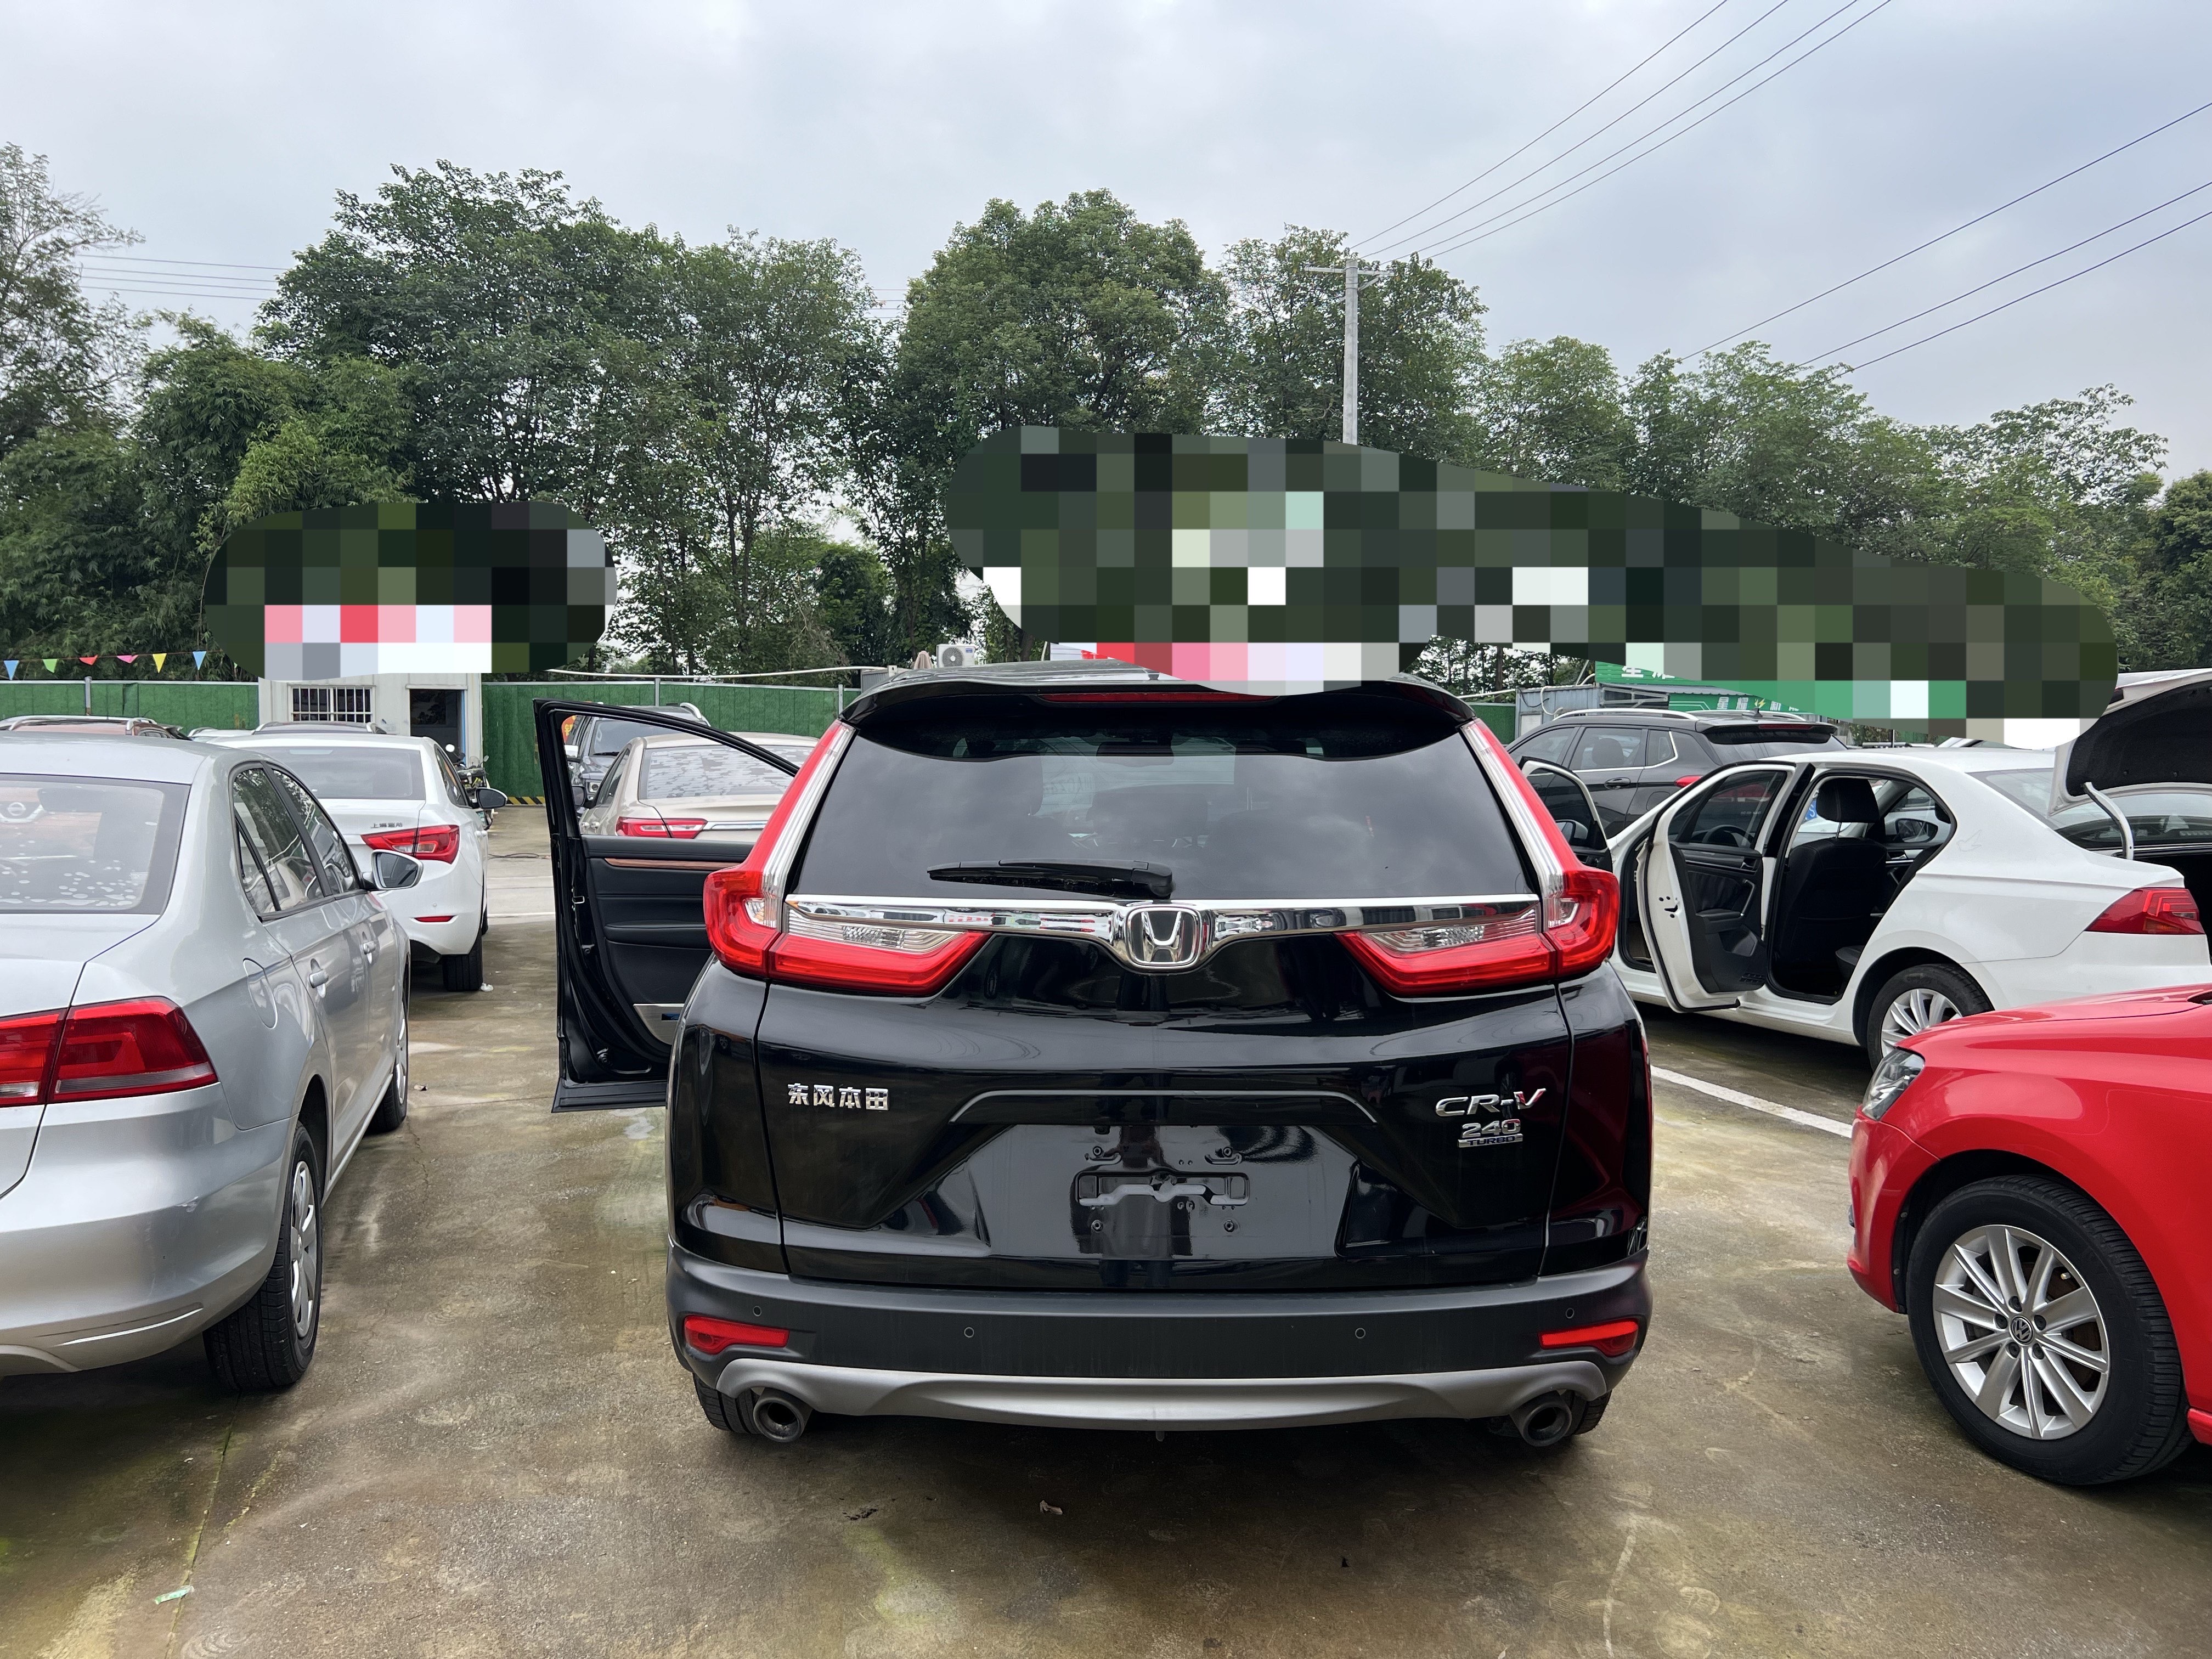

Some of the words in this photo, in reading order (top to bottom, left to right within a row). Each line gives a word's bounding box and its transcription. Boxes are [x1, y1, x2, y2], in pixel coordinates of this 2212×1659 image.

[788, 1083, 889, 1111] 东风本田
[1435, 1088, 1546, 1117] CR-V
[1462, 1119, 1521, 1138] 240
[1466, 1136, 1516, 1146] TURBO
